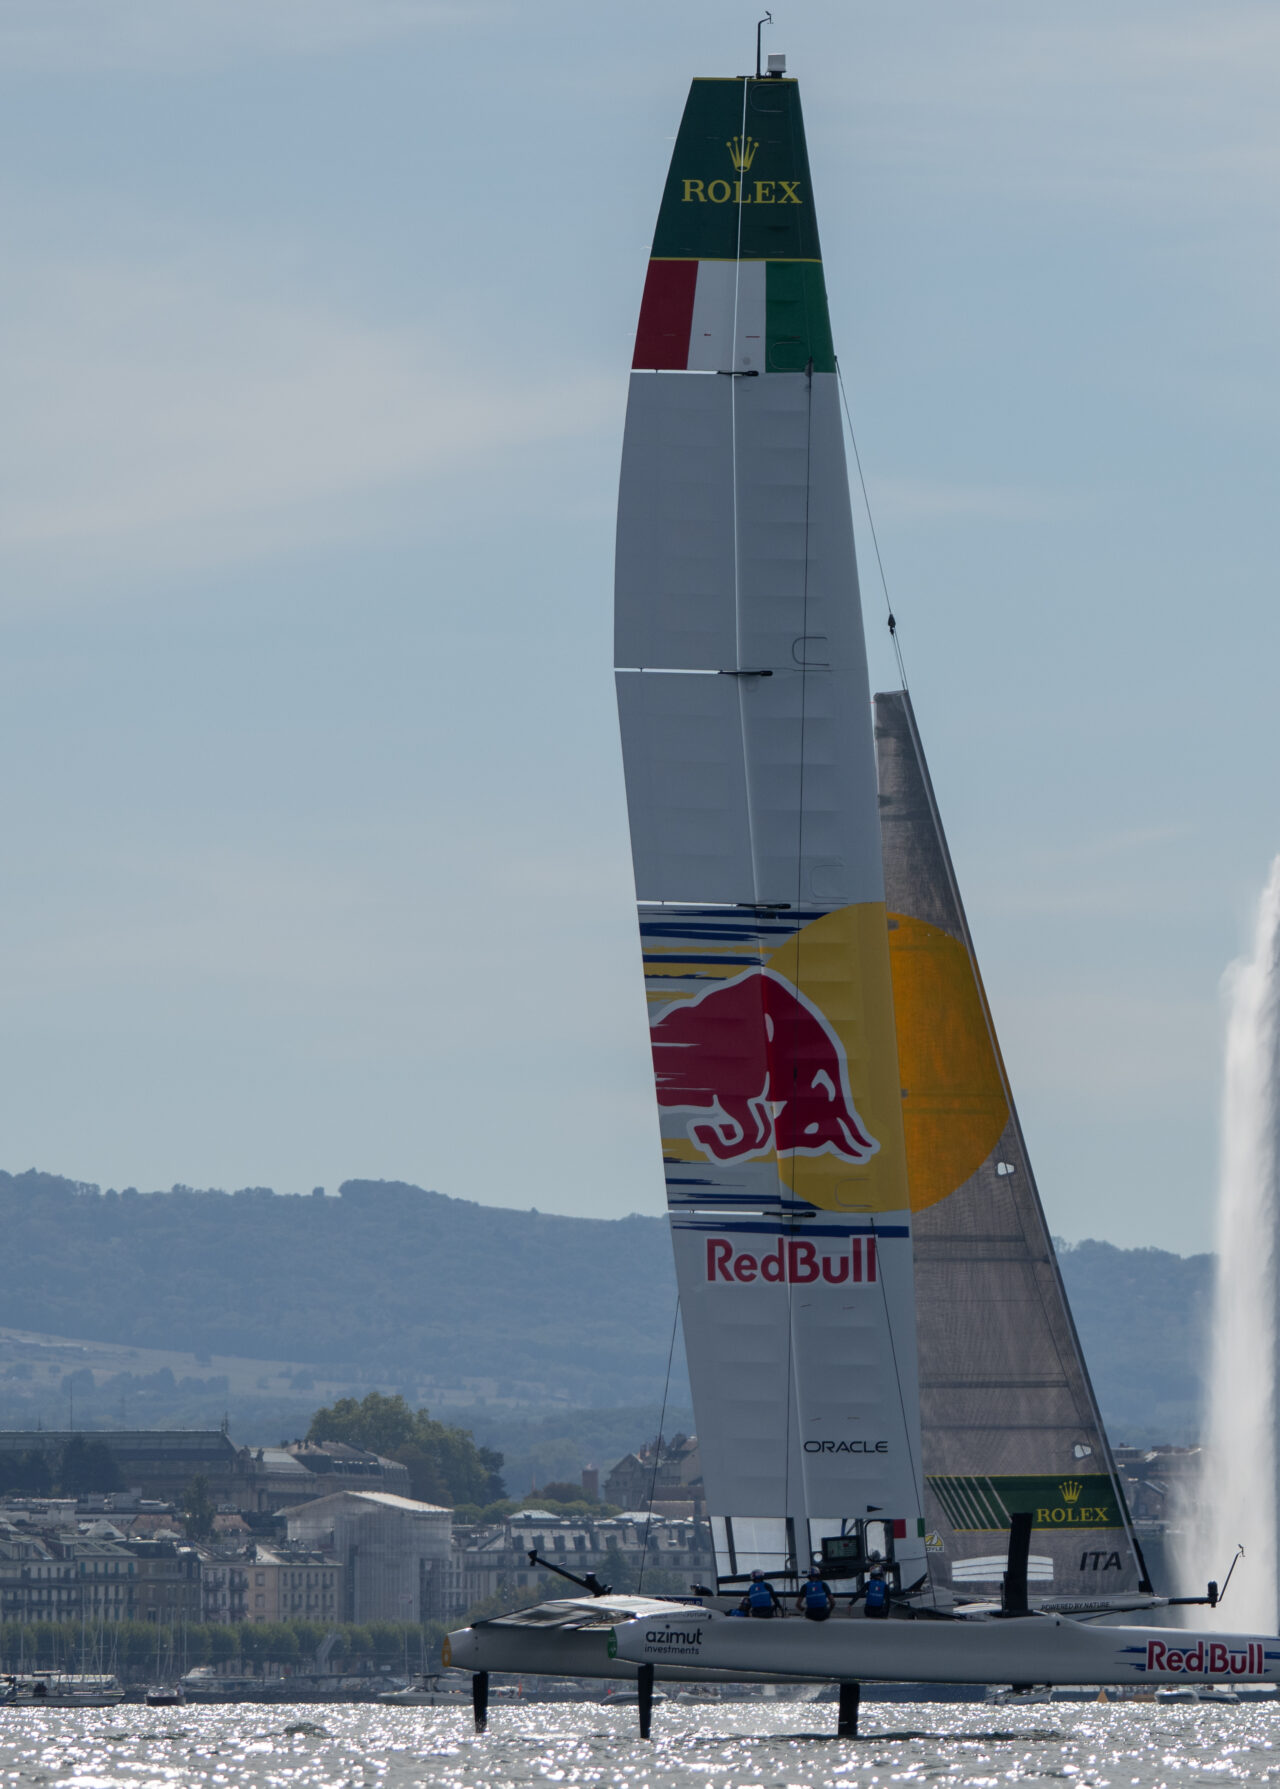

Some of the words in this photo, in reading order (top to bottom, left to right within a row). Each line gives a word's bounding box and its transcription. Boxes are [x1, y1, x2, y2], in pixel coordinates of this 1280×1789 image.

[681, 179, 803, 204] ROLEX
[804, 1440, 889, 1453] ORACLE
[1037, 1508, 1109, 1522] ROLEX
[1079, 1551, 1122, 1571] ITA
[1041, 1602, 1073, 1610] POWERED
[645, 1624, 703, 1645] azimut
[644, 1645, 700, 1655] investments
